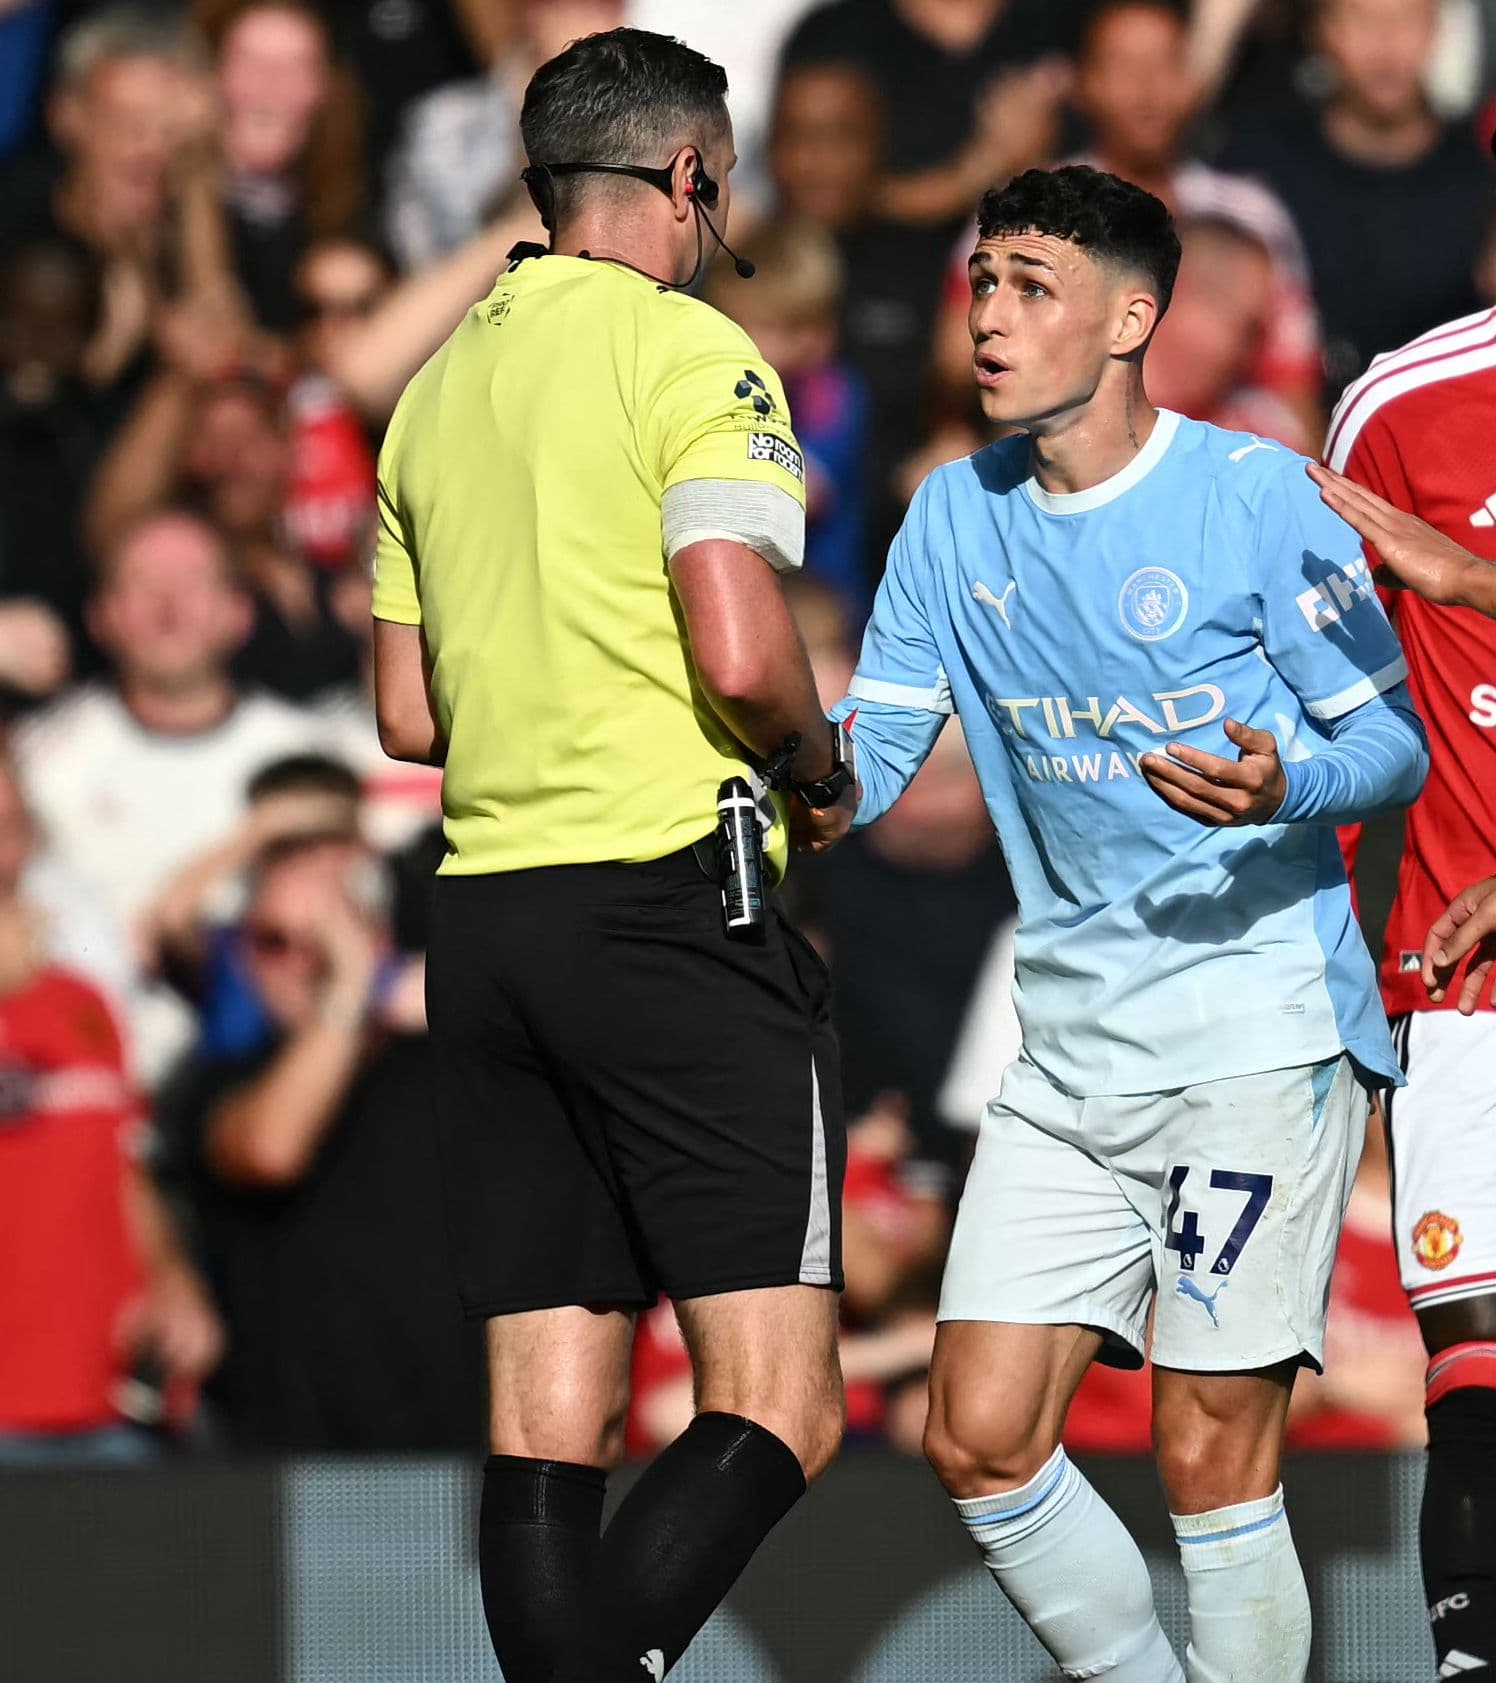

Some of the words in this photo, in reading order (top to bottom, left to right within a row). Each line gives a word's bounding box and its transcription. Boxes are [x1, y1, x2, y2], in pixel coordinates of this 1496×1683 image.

[748, 432, 775, 448] No
[774, 438, 802, 469] room
[984, 683, 1227, 740] TIHAD
[1027, 750, 1146, 784] AIRWAY
[1164, 1165, 1274, 1276] 47
